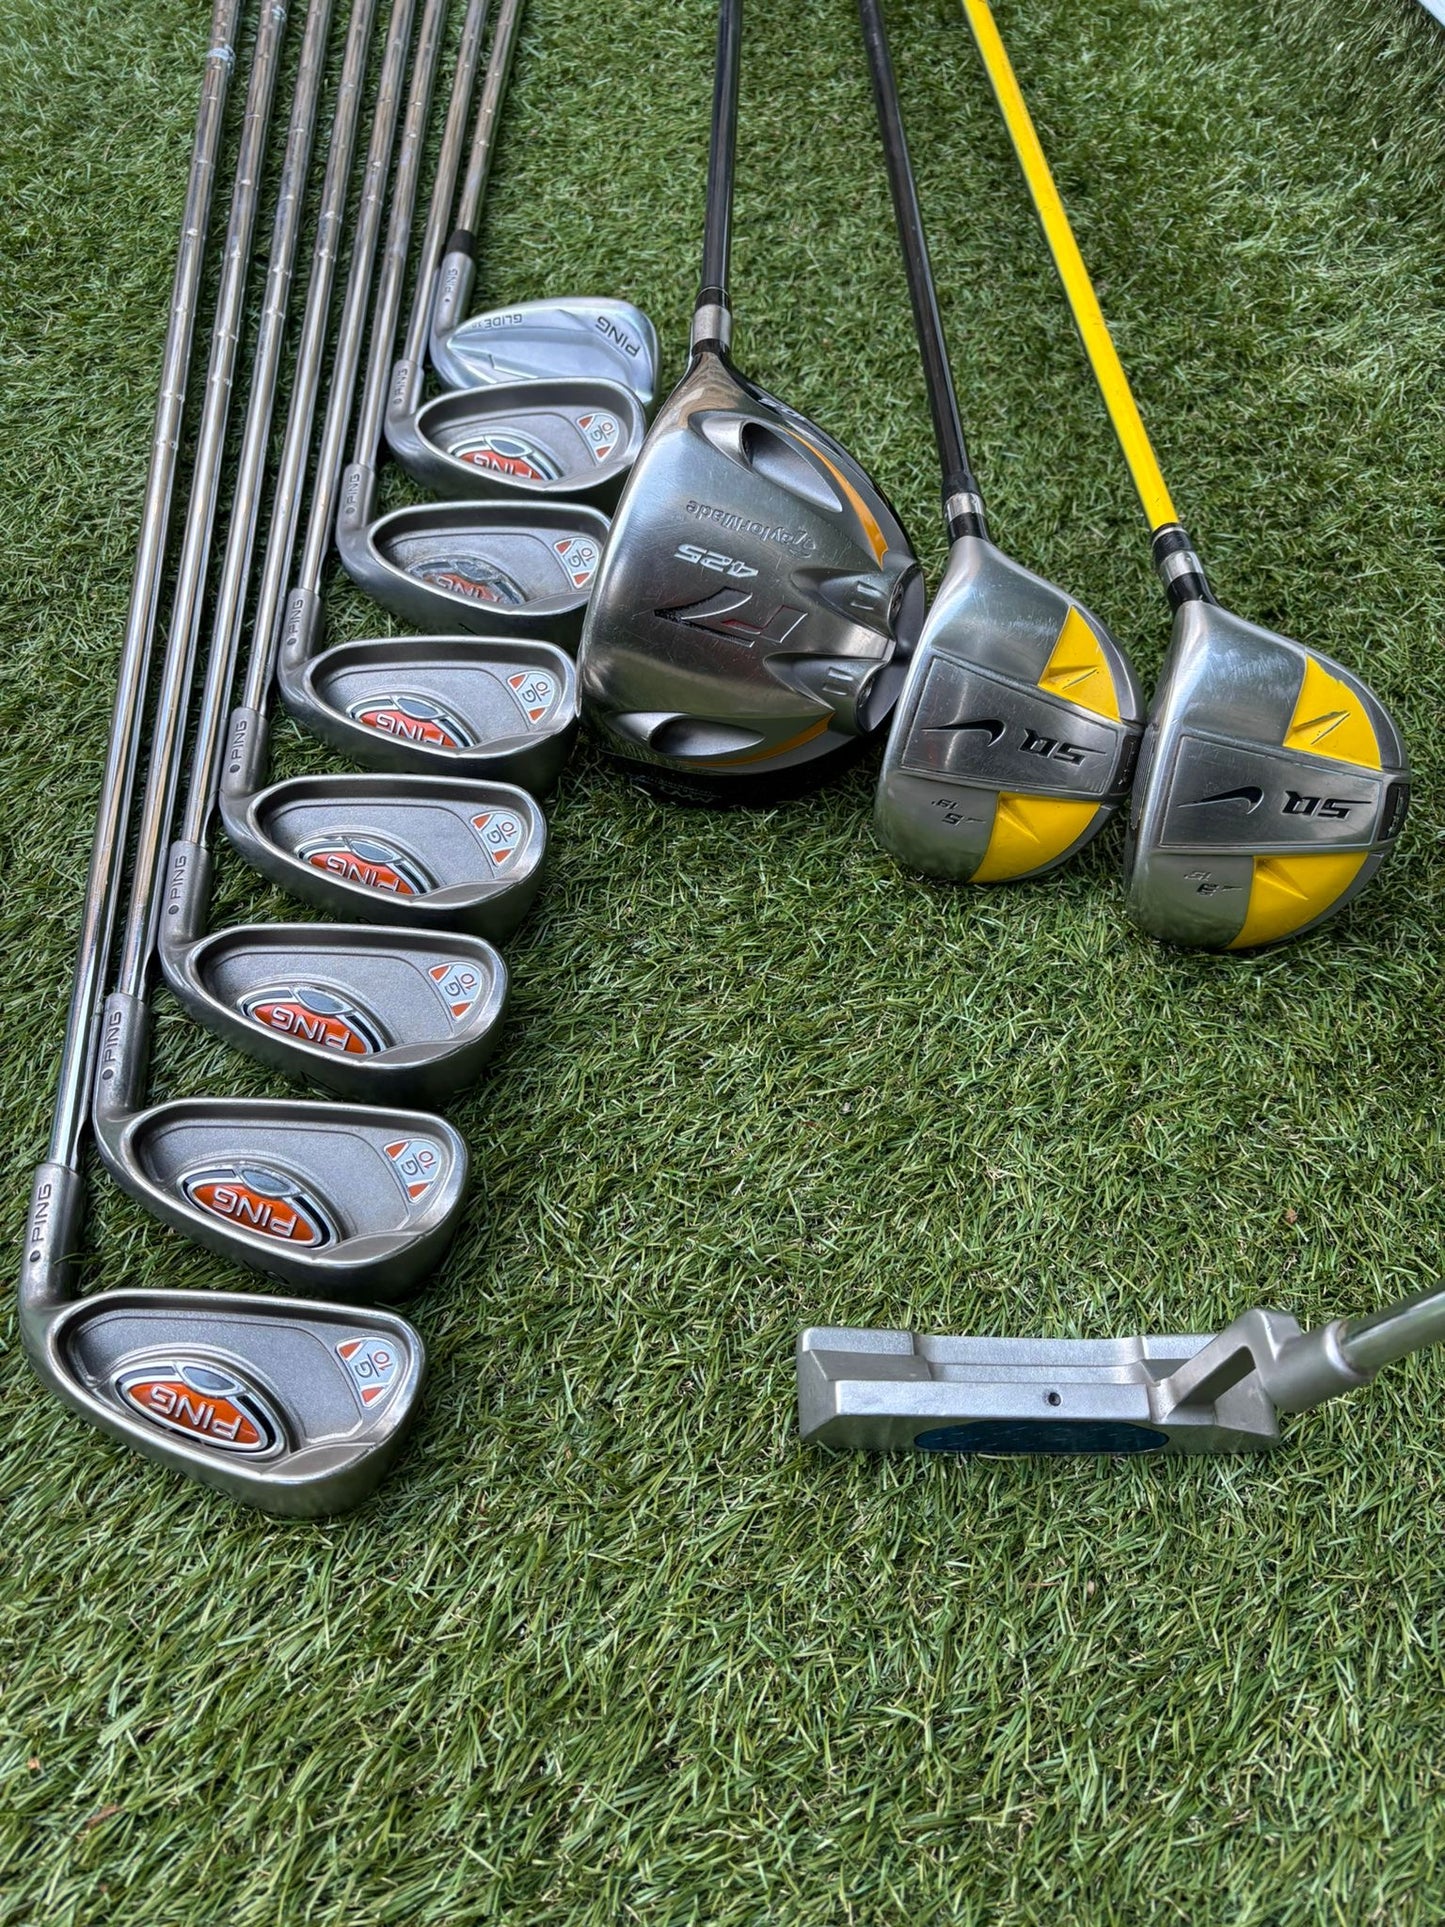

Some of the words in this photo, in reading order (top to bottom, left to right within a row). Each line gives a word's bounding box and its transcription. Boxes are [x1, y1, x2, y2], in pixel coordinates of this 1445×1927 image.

[445, 268, 458, 293] PING
[484, 314, 523, 329] GLIDE
[596, 315, 640, 357] PING
[394, 368, 408, 395] PING
[346, 474, 361, 505] PING
[685, 500, 817, 558] TaylorMade
[673, 543, 759, 579] 425
[289, 599, 303, 633] PING
[231, 719, 248, 759] PING
[1017, 727, 1107, 767] SQ
[1281, 790, 1373, 821] SQ
[170, 855, 188, 900] PING
[445, 980, 462, 997] G
[104, 1011, 122, 1061] PING
[270, 1006, 351, 1051] PING
[401, 1158, 419, 1176] G
[33, 1183, 52, 1242] PING
[213, 1187, 298, 1238] PING
[354, 1359, 374, 1378] G
[149, 1385, 242, 1441] PING
